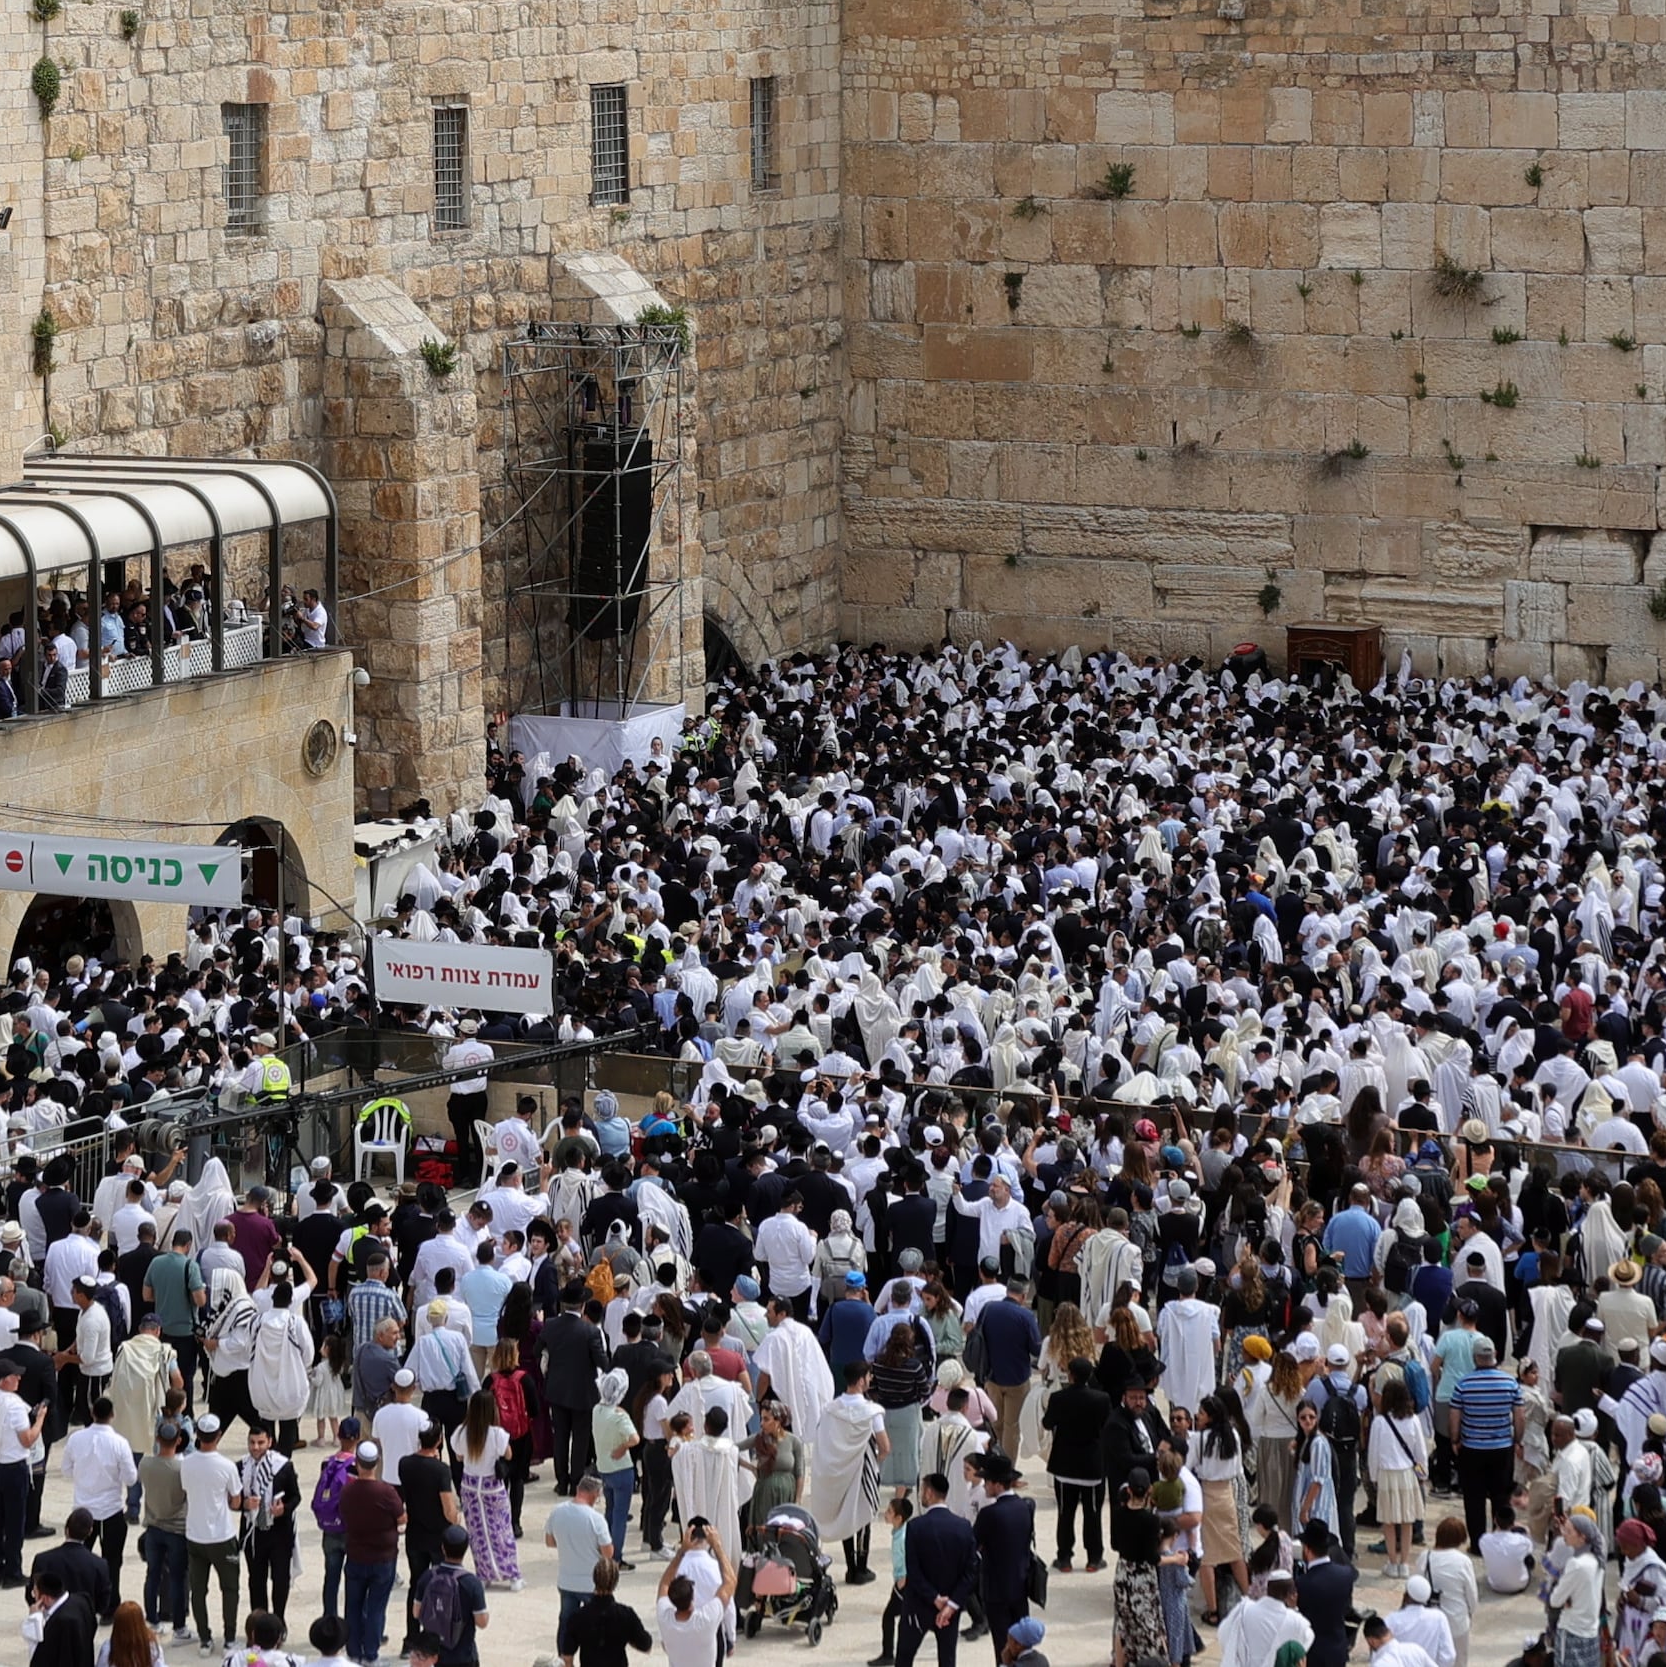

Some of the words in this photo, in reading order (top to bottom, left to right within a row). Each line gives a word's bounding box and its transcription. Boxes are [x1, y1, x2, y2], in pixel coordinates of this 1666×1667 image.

[86, 853, 184, 887] כניסה
[386, 962, 435, 981] רפואי
[440, 966, 481, 985] צוות
[487, 970, 540, 989] עמדת
